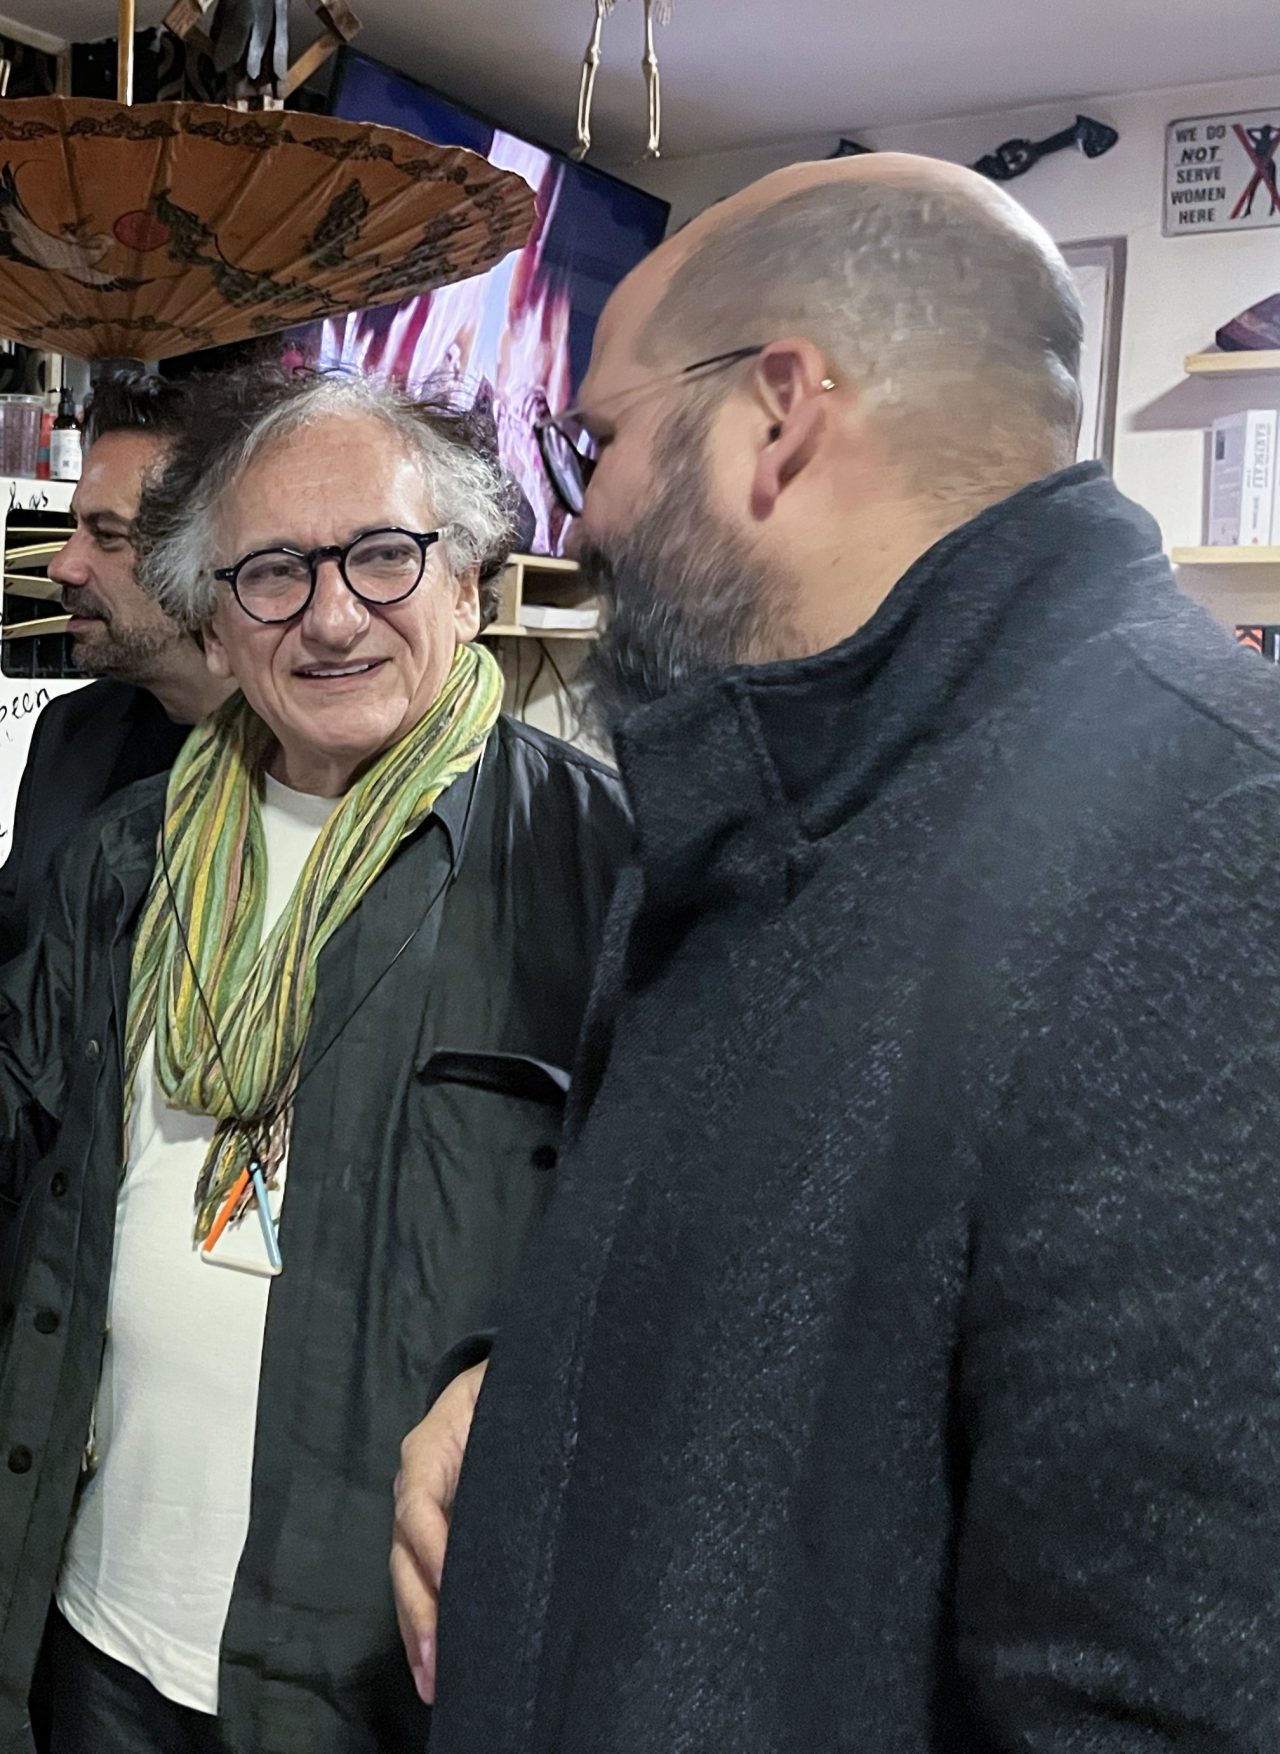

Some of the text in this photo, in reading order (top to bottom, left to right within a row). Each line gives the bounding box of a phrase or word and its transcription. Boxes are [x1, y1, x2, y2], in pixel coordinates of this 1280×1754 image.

[1176, 125, 1226, 142] WE DO
[1181, 145, 1220, 162] NOT
[1176, 165, 1222, 184] SERVE
[1170, 186, 1227, 205] WOMEN
[1178, 207, 1216, 224] HERE
